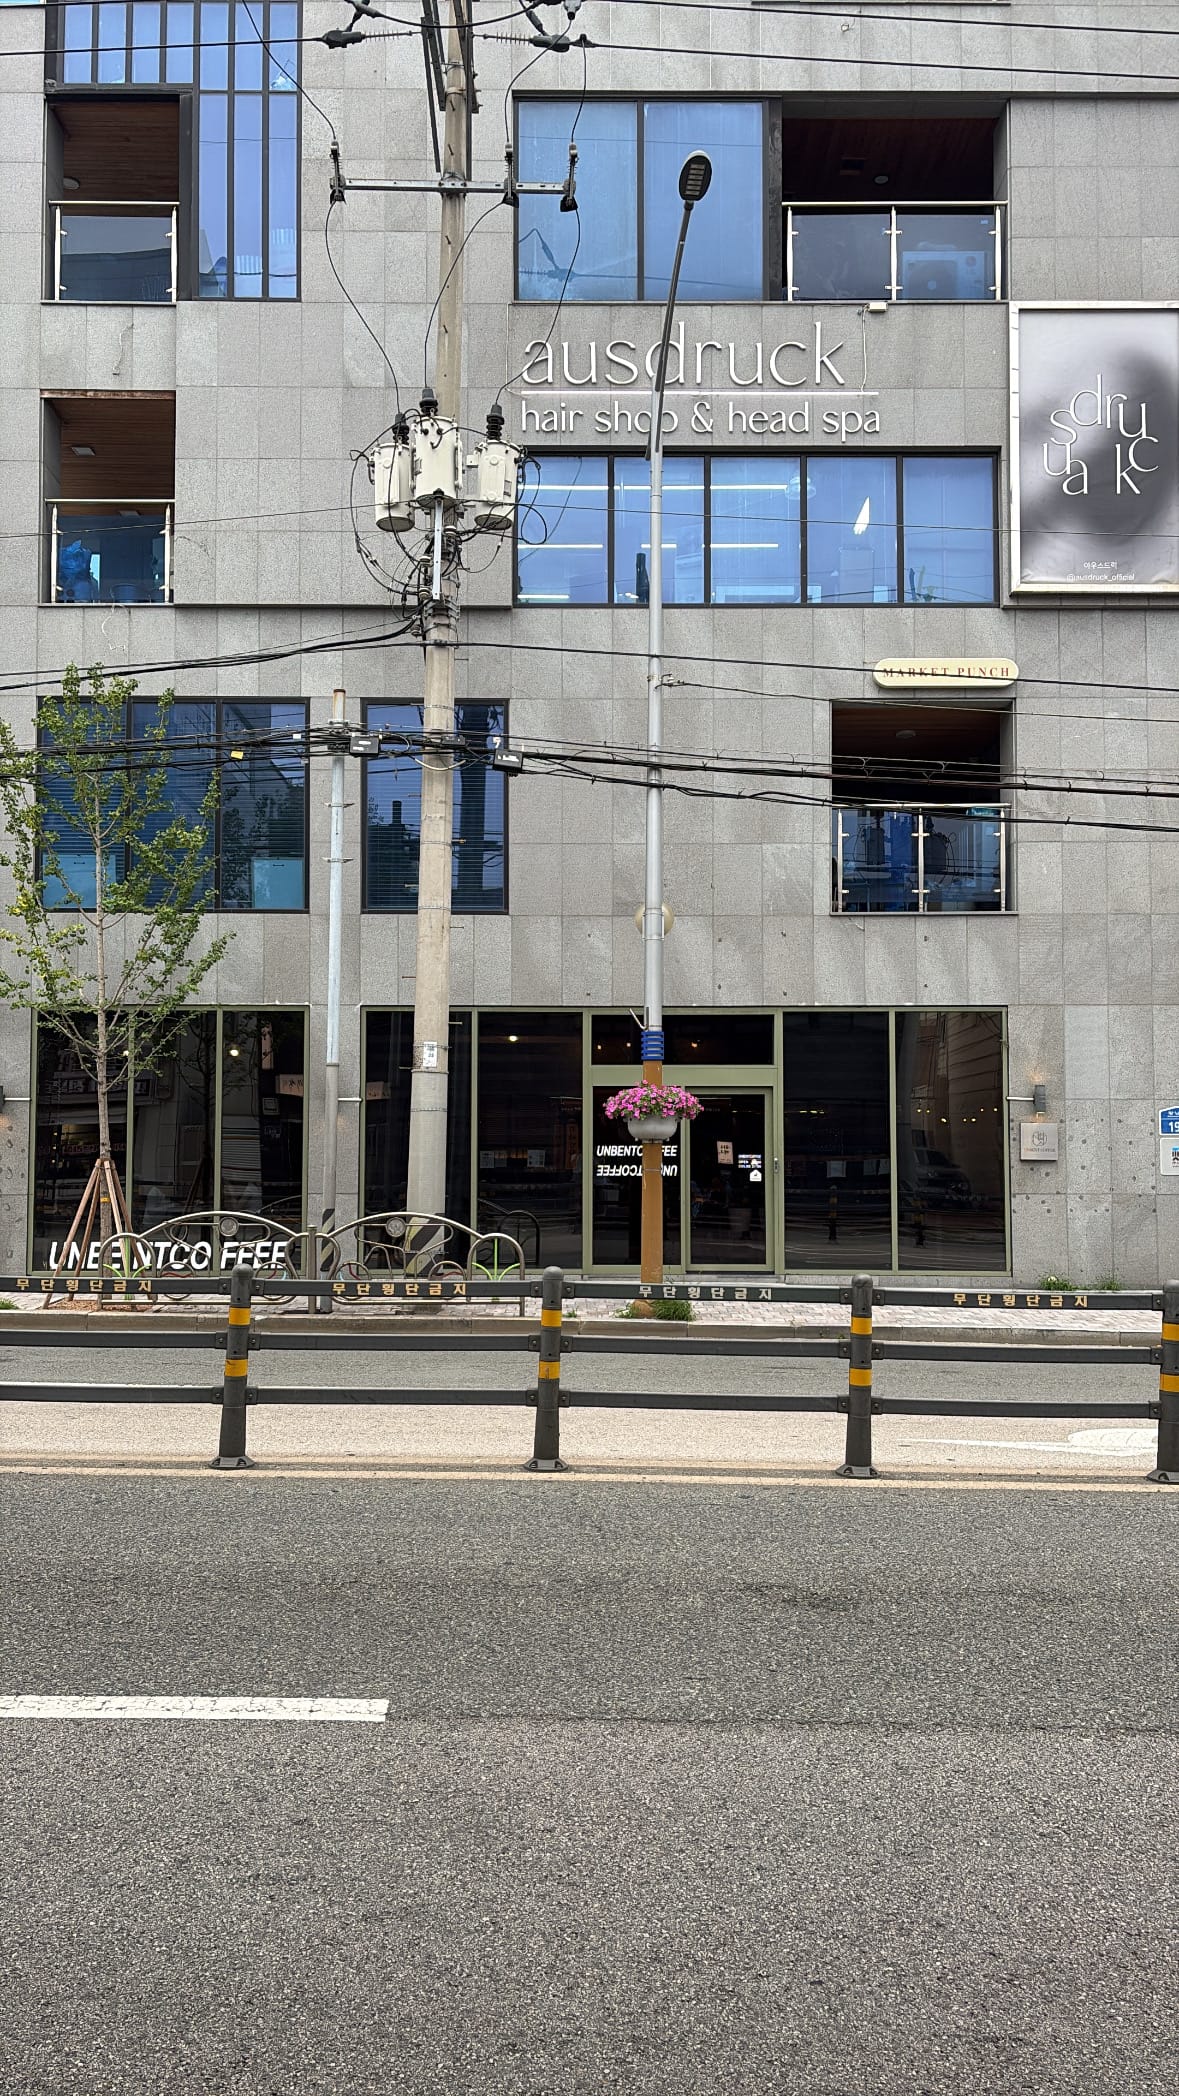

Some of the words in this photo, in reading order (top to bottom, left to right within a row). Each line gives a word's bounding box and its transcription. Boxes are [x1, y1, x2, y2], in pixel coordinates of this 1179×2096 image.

[521, 321, 845, 386] ausdruck
[521, 401, 584, 433] hair
[691, 401, 714, 433] &
[728, 401, 810, 433] head
[822, 408, 881, 443] spa
[883, 667, 949, 678] MARKET
[957, 667, 1010, 678] PUNCH
[596, 1145, 678, 1157] UNBENTCEE
